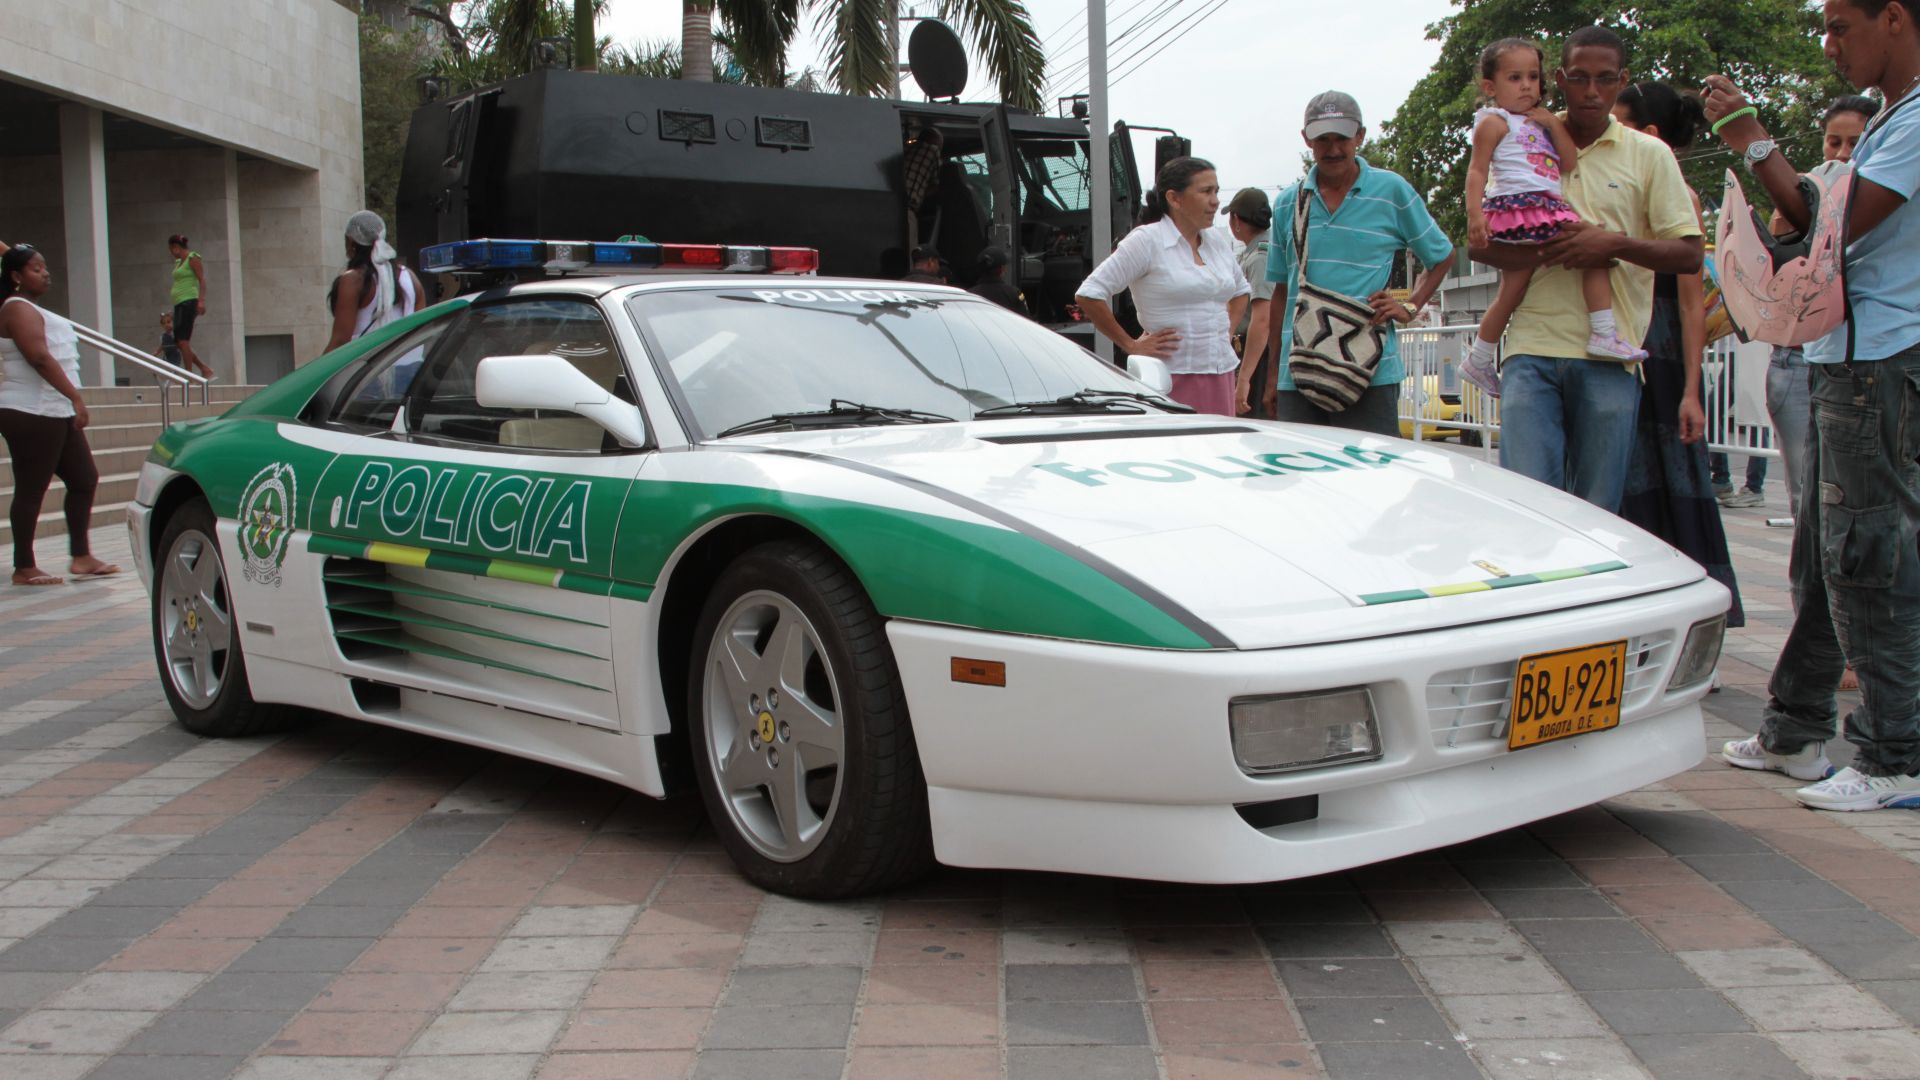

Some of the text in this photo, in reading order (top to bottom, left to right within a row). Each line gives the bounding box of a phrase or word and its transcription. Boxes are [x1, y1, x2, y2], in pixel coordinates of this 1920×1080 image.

[752, 289, 927, 303] POLICIA
[1032, 445, 1430, 487] POLICIA
[345, 461, 592, 564] POLICIA
[1538, 720, 1572, 739] BOGOTA
